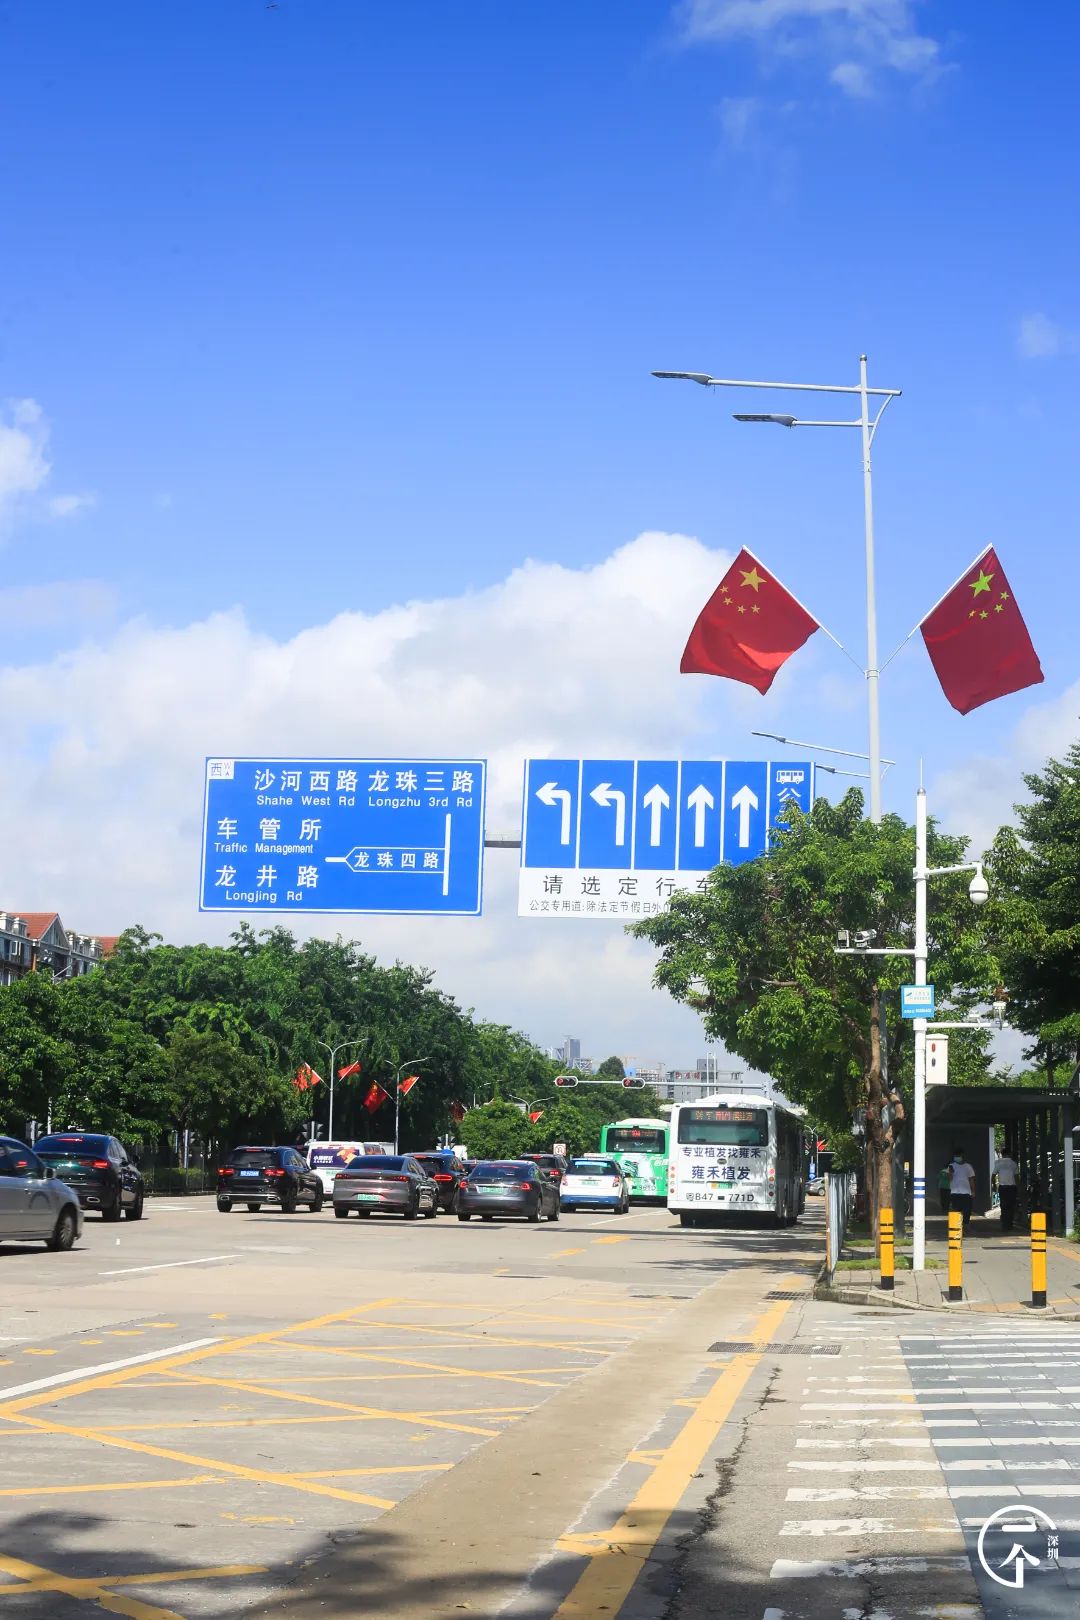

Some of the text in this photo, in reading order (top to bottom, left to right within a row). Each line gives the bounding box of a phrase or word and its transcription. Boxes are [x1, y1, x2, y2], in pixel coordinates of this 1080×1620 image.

[254, 768, 474, 793] 沙河西路 龙珠三路
[256, 795, 473, 809] Shahe West Rd Longzhu 3rd Rd
[216, 817, 322, 841] 车管所
[214, 842, 313, 855] Traffic Management
[354, 851, 439, 869] 龙珠四路
[214, 864, 319, 888] 龙井路
[225, 890, 303, 903] Longjing Rd
[682, 1147, 762, 1159] 专业植发找雍禾
[692, 1165, 751, 1180] 雍禾植发
[728, 1193, 755, 1202] 771D
